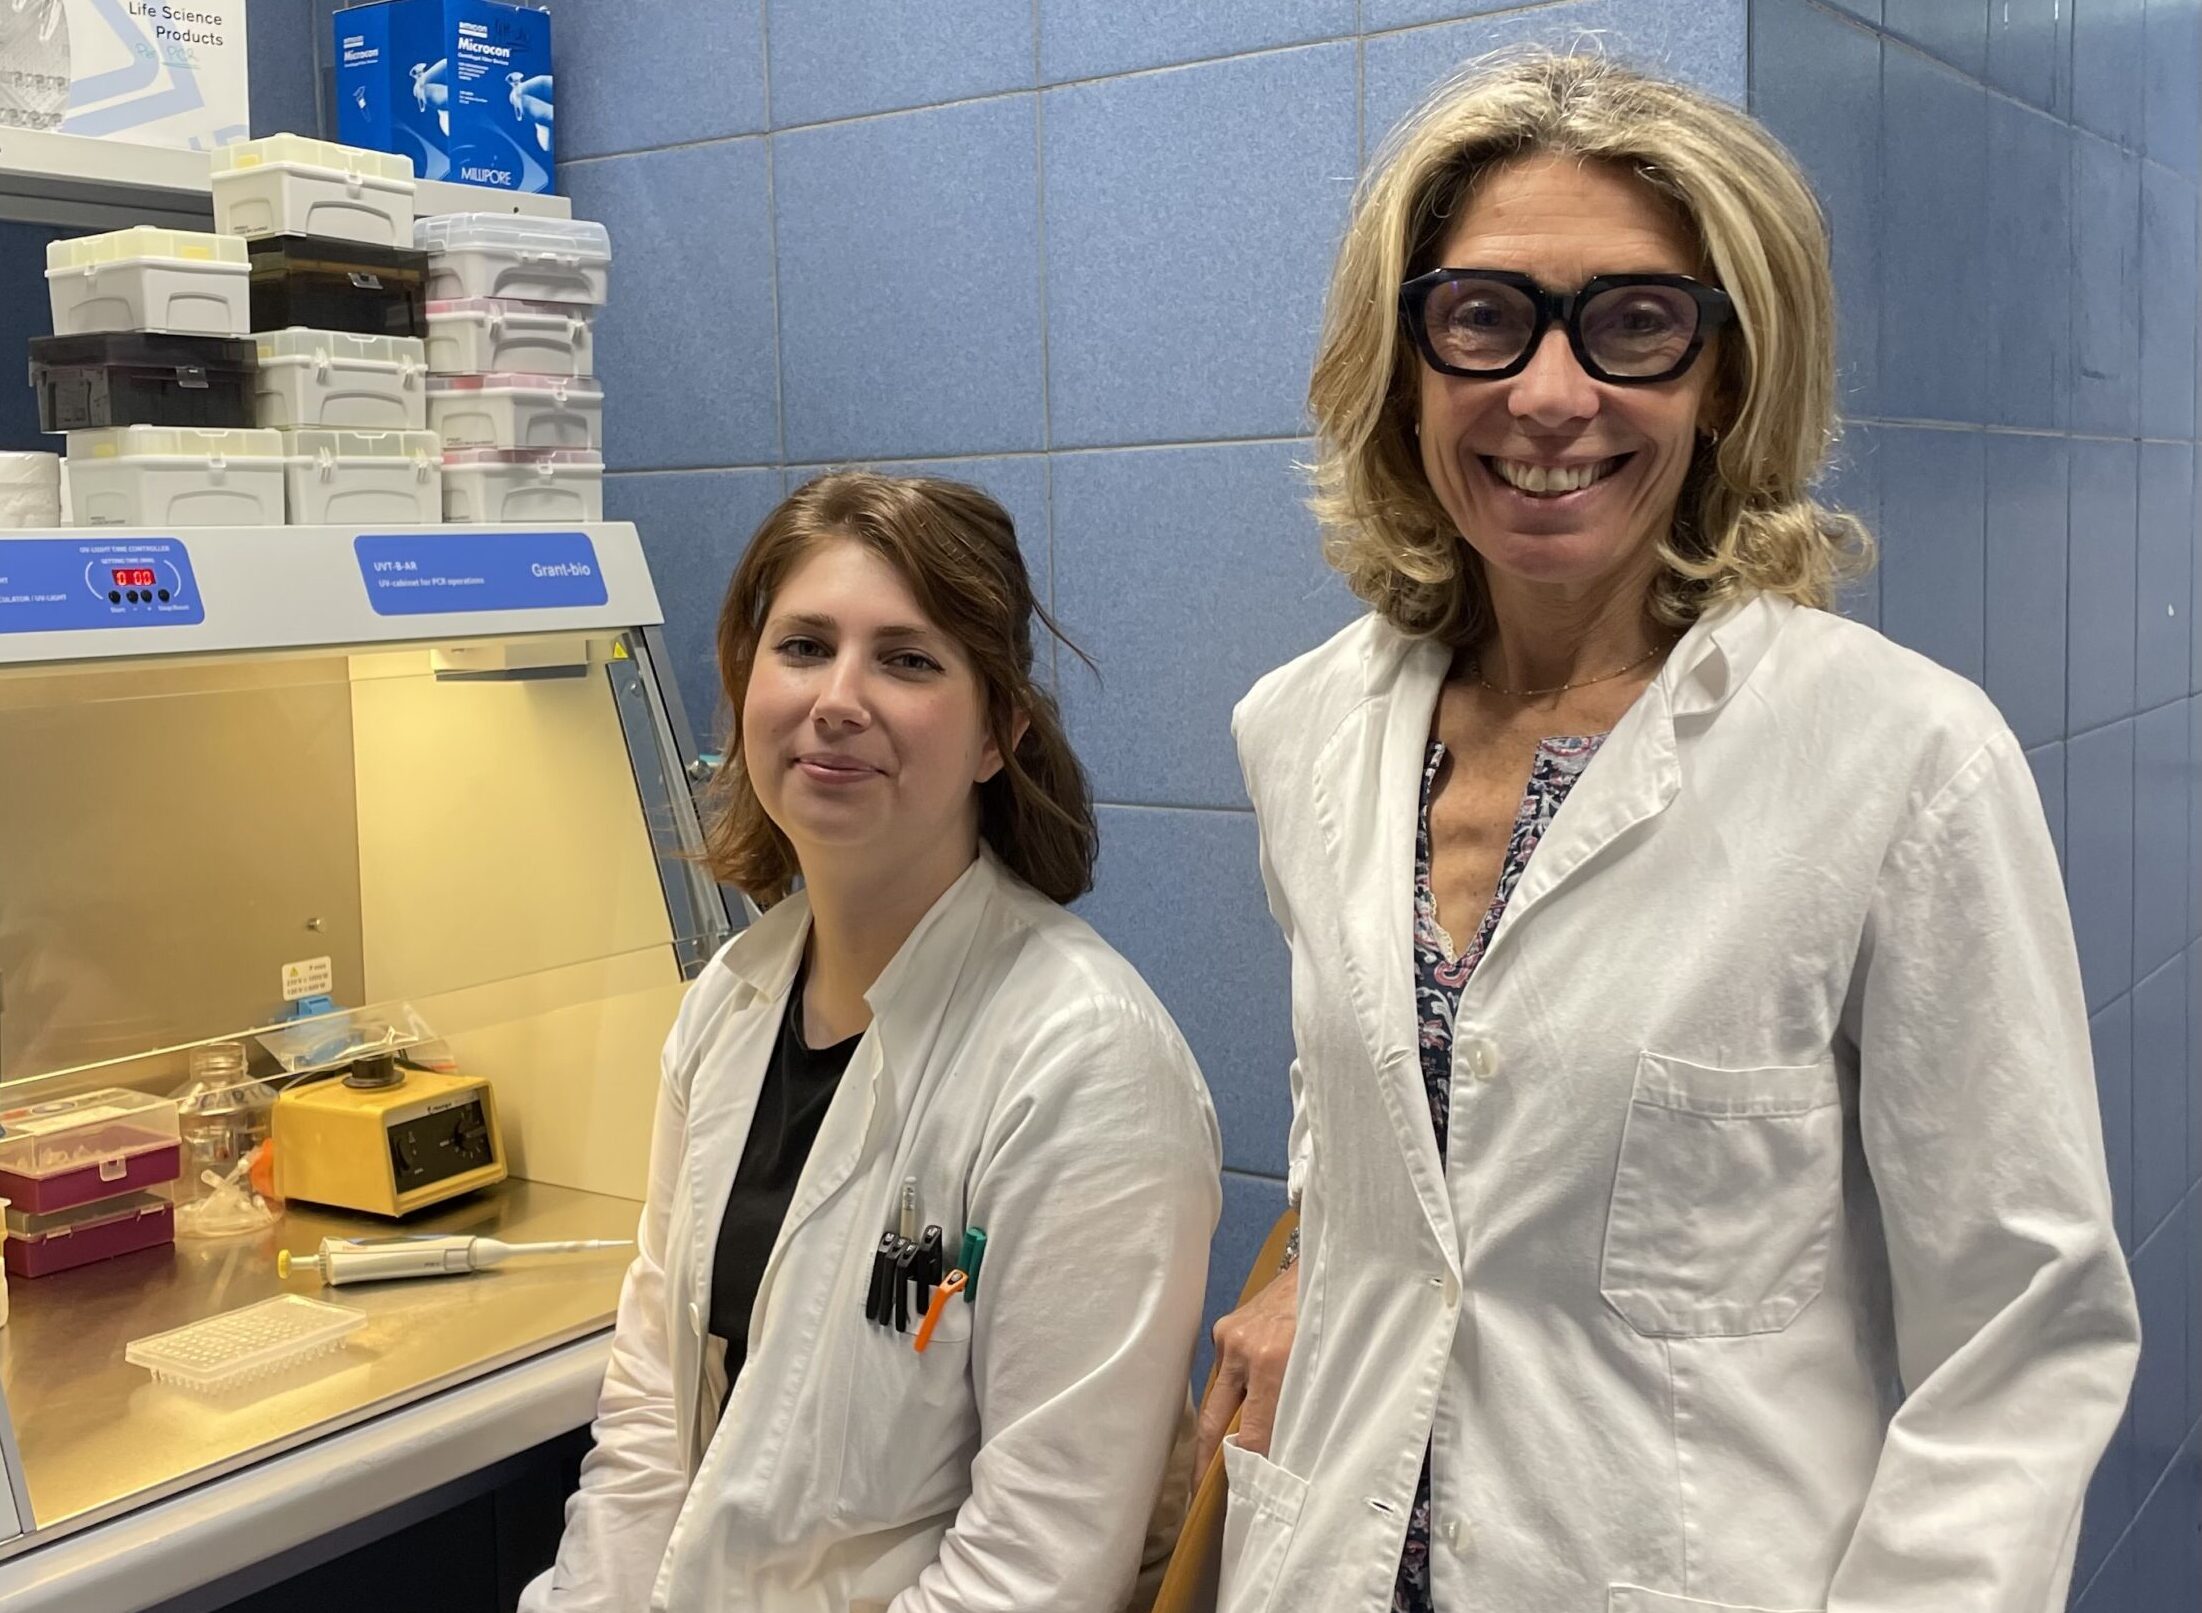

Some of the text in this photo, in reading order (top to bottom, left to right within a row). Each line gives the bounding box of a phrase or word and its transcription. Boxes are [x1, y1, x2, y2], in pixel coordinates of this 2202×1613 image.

[129, 1, 222, 25] Life Science
[156, 25, 223, 46] Products
[457, 36, 511, 58] Microcon
[461, 166, 512, 186] MILLIPORE
[531, 562, 591, 578] Grant-bio
